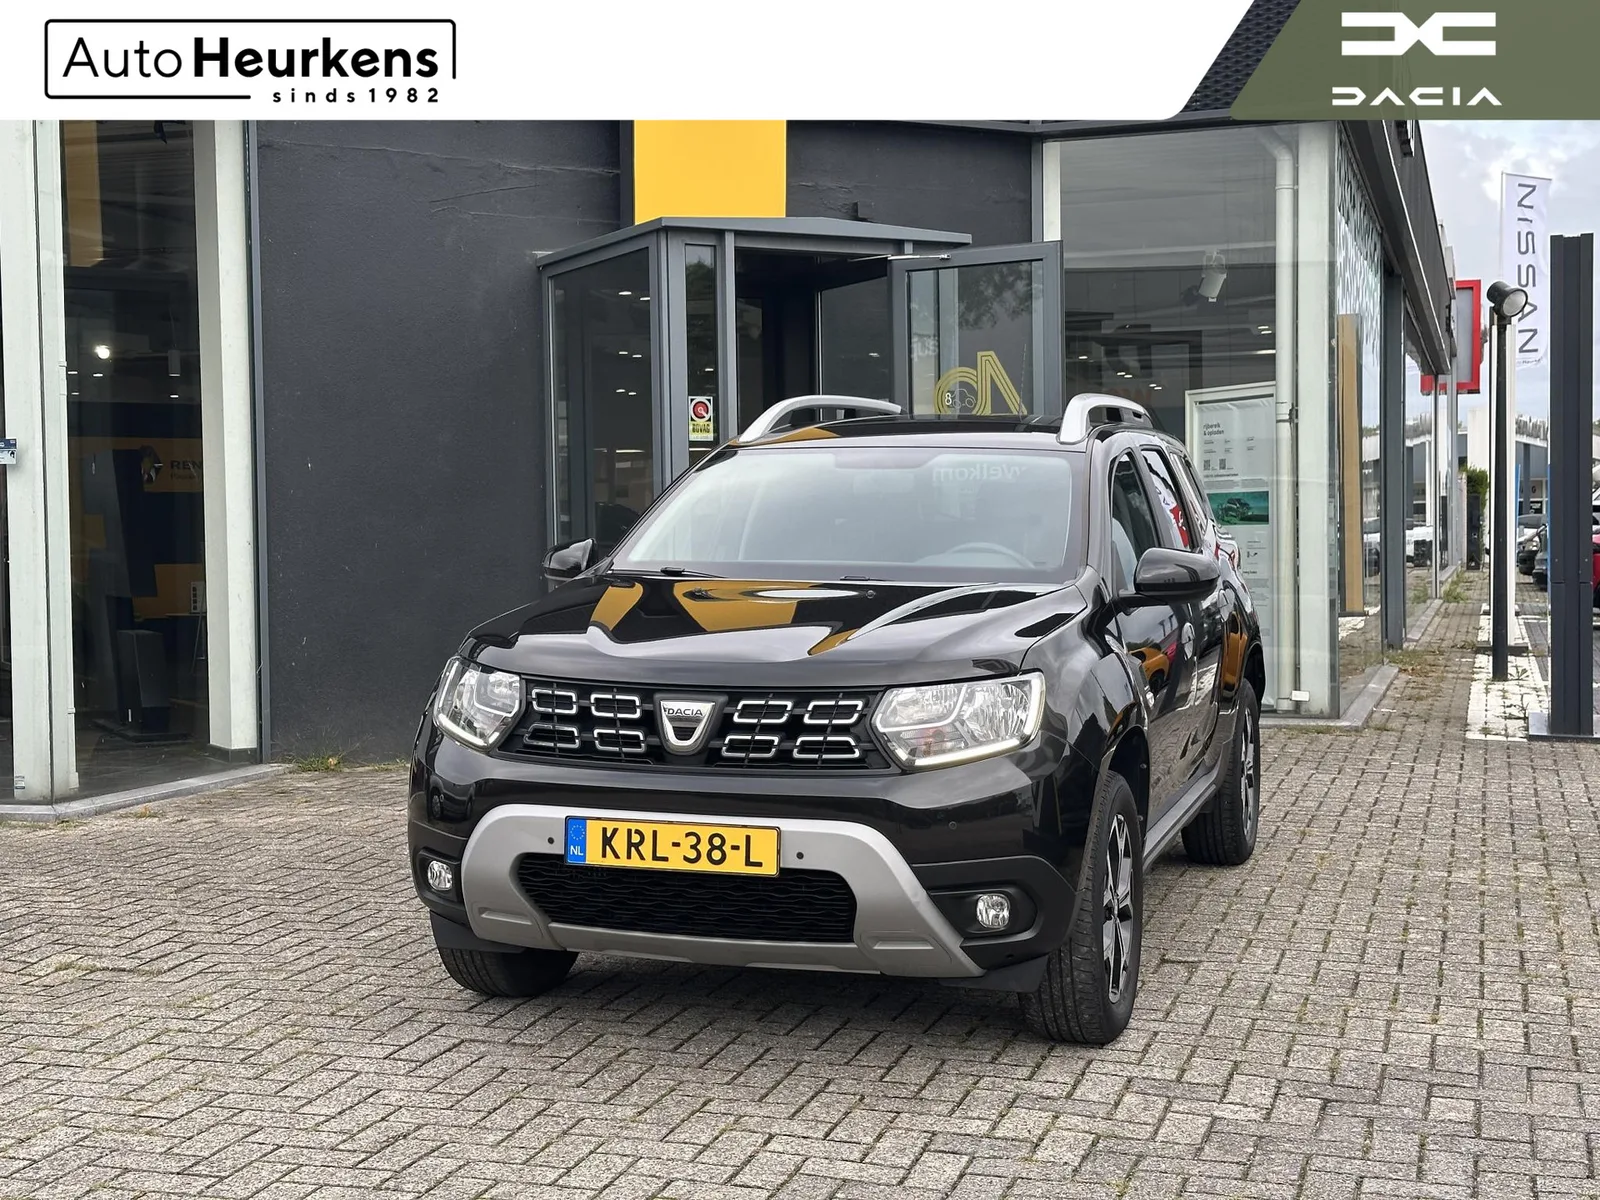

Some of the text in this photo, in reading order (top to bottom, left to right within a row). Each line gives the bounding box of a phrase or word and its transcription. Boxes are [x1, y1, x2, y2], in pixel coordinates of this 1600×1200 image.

[1517, 183, 1538, 353] NISSAN
[667, 708, 703, 716] DACIA
[570, 845, 583, 856] NL
[601, 827, 763, 867] KRL-38-L
